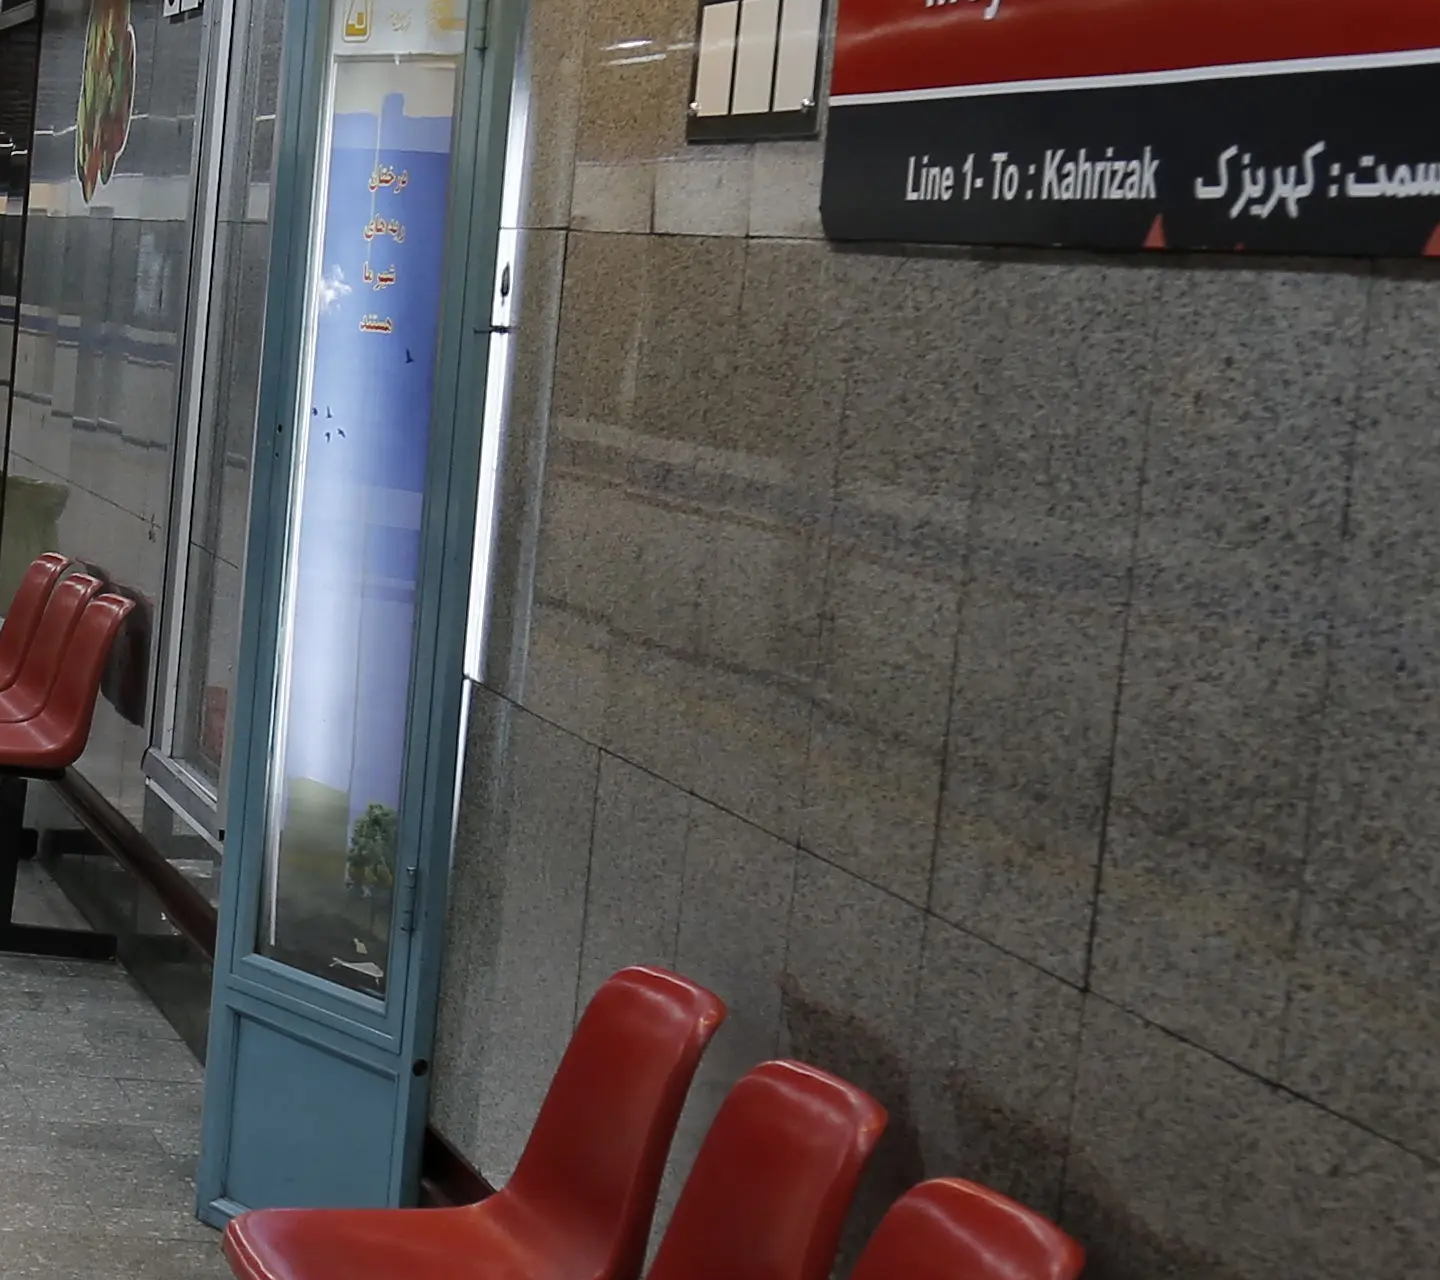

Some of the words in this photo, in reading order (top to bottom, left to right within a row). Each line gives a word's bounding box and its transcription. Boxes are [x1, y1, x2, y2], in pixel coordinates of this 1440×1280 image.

[905, 154, 955, 201] Line
[991, 151, 1020, 201] To
[1040, 145, 1160, 200] Kahrizak
[1193, 140, 1326, 219] کهریزک
